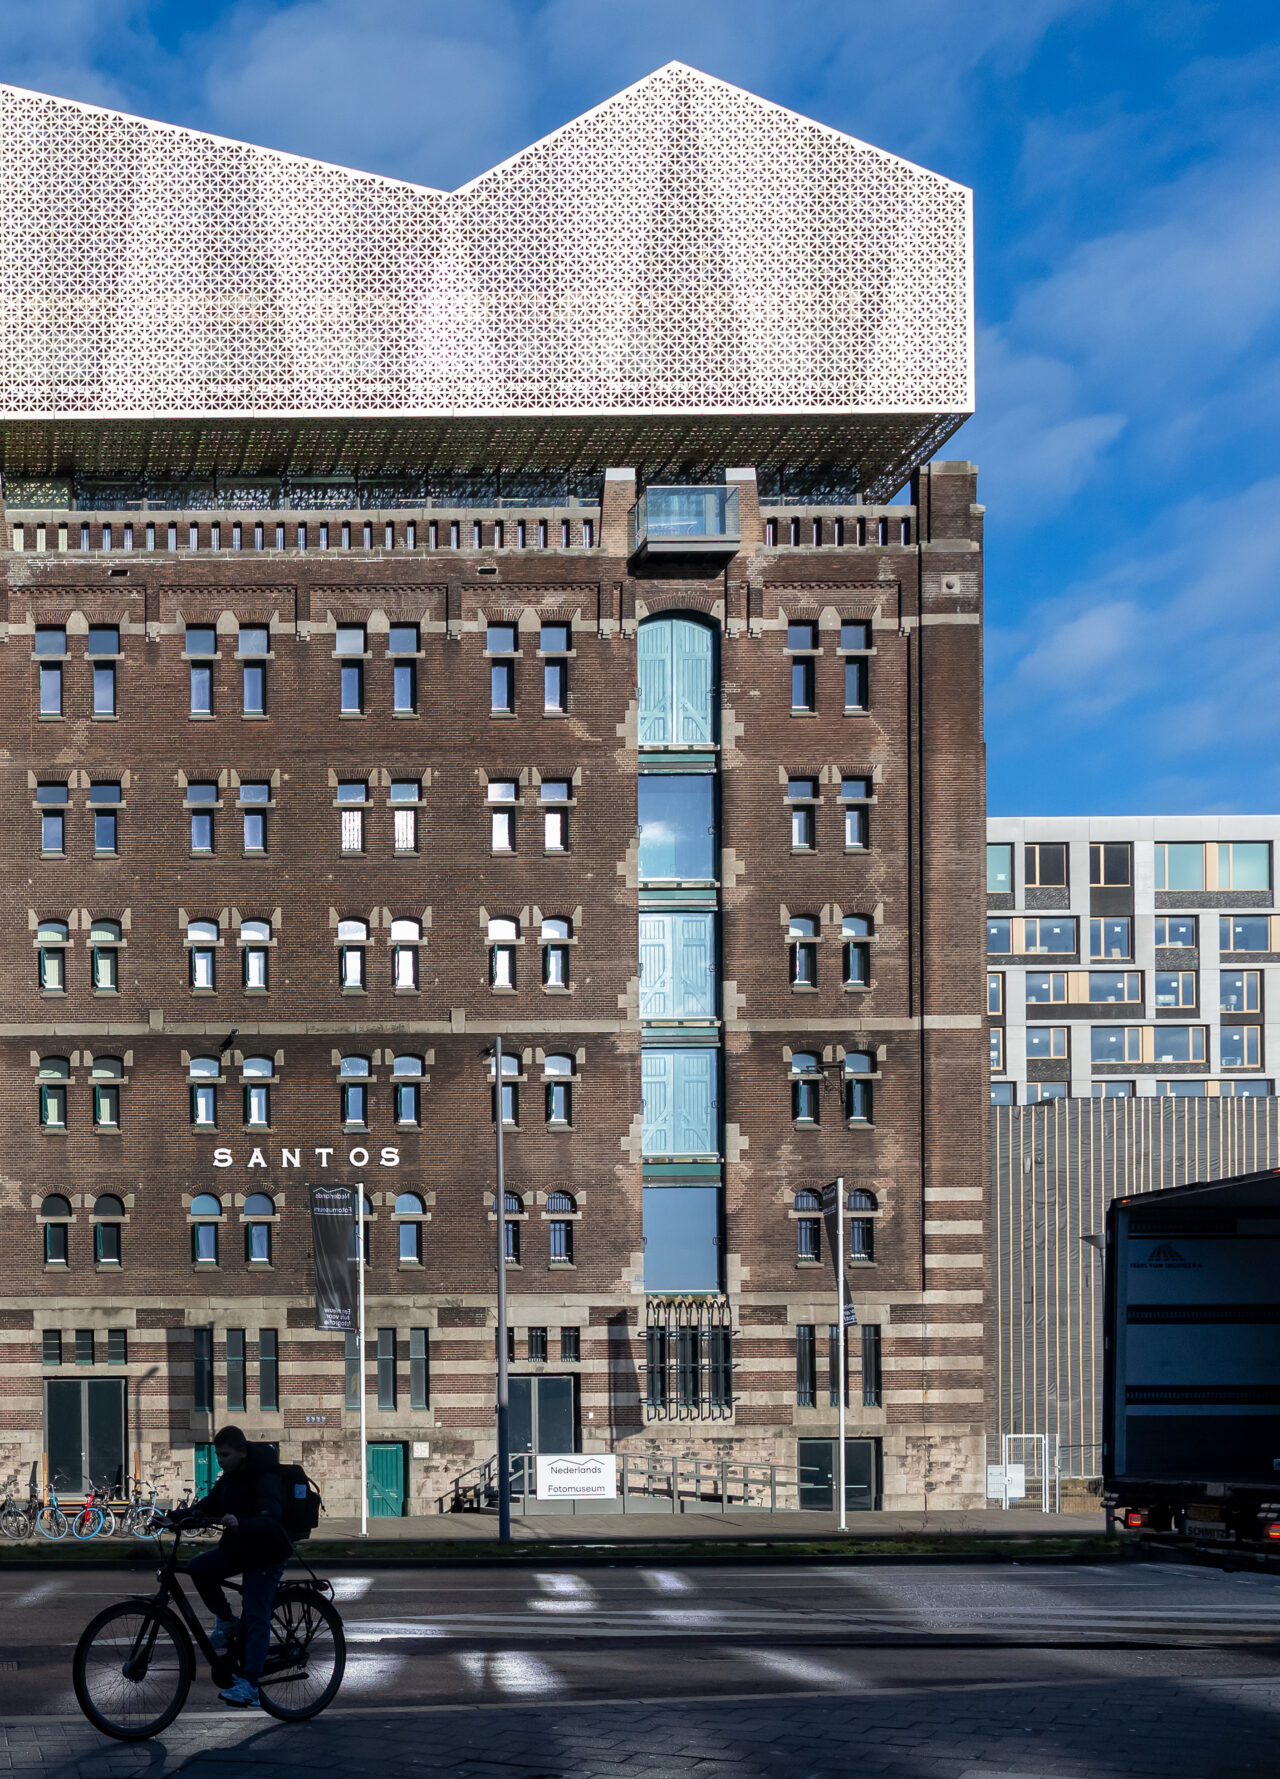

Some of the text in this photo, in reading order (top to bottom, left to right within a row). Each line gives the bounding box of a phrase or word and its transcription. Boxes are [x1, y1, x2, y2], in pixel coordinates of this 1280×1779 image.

[212, 1147, 400, 1168] SANTOS
[550, 1466, 602, 1474] Nederlands
[547, 1485, 606, 1493] Fotomuseum
